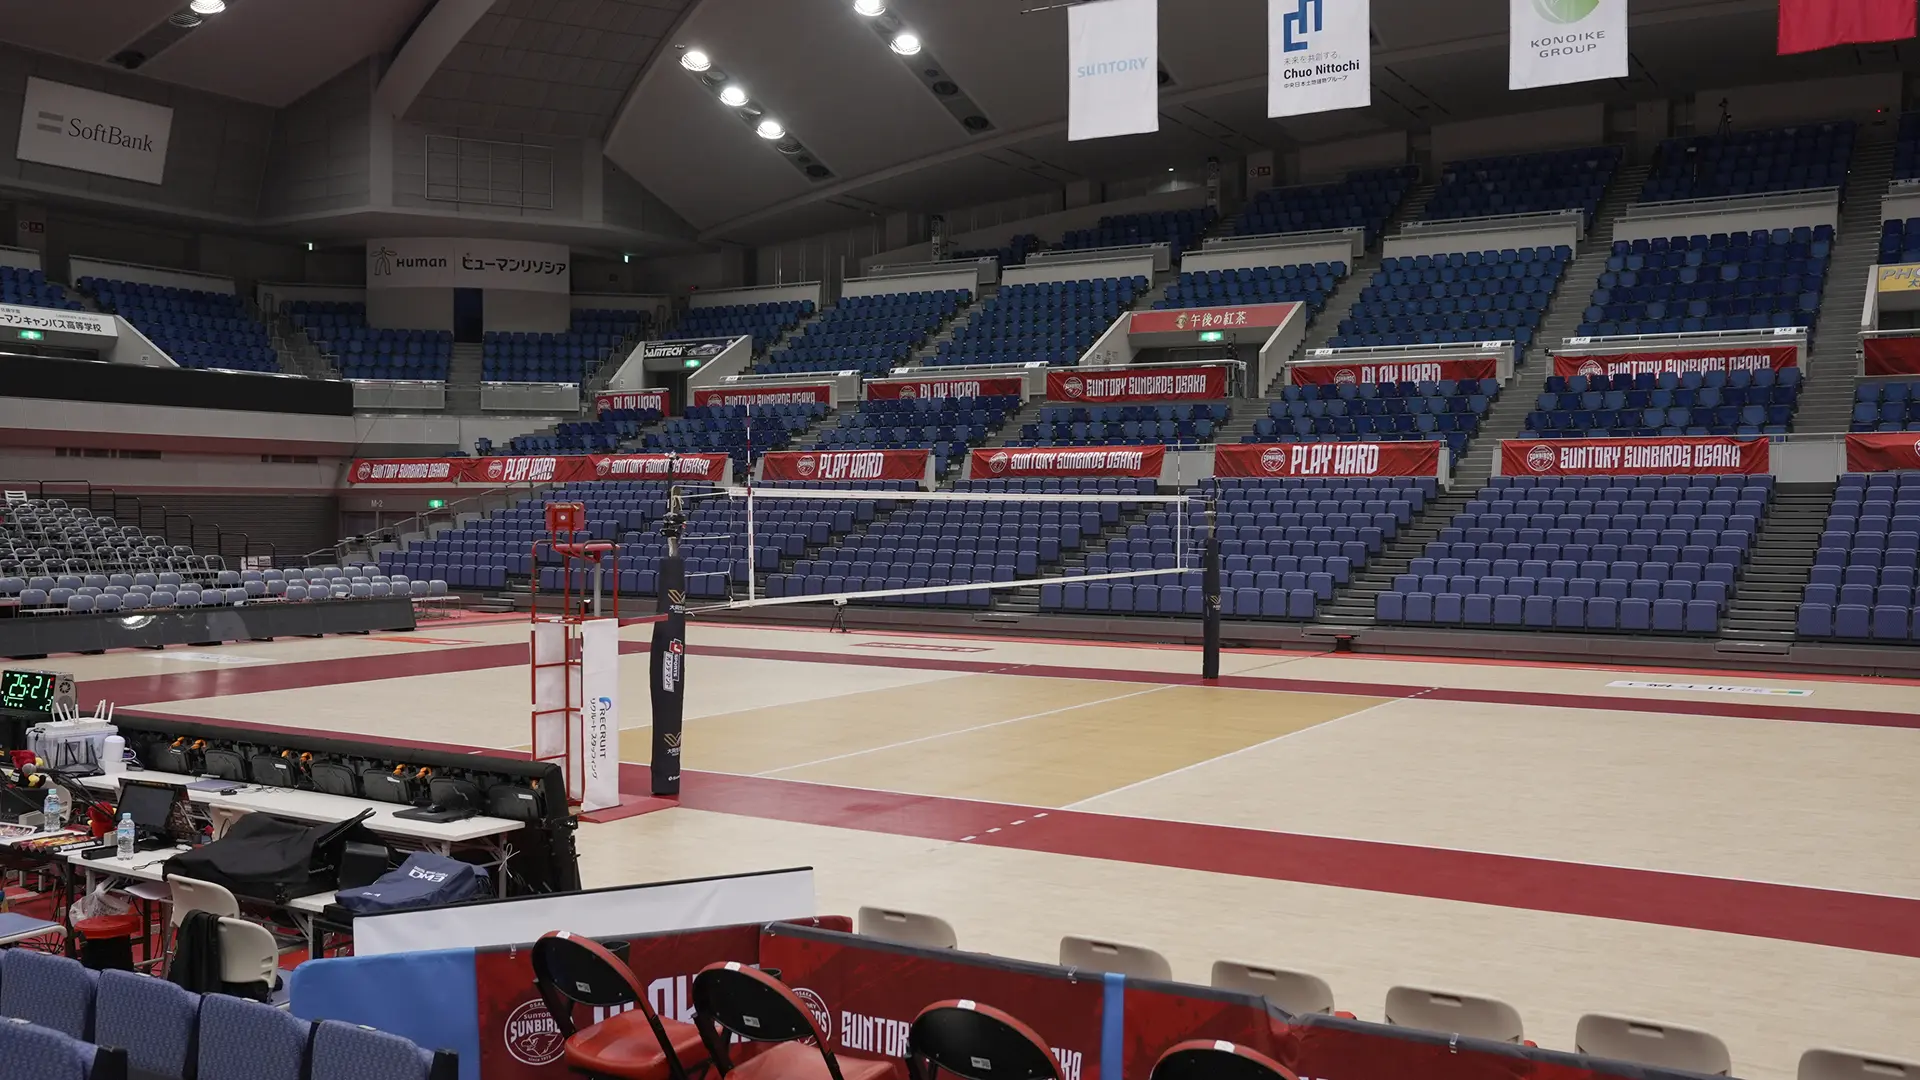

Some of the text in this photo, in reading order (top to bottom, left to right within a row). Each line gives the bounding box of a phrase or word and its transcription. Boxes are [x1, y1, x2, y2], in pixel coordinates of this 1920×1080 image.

[1531, 31, 1605, 48] KONOIKE
[1540, 44, 1597, 58] GROUP
[1077, 57, 1149, 78] SUNTORY
[1284, 59, 1360, 80] Chuo Nittochi
[68, 117, 153, 152] SoftBank
[1190, 311, 1247, 327] 午後の紅茶
[1086, 375, 1207, 397] SUNTORY SUNBIRDS OSAKA
[611, 459, 646, 474] SUNTORY
[682, 458, 710, 475] OSAKA
[818, 453, 884, 478] PLAY HARD
[1011, 452, 1144, 470] SUNTORY SUNBIRDS OSAKA
[1290, 445, 1379, 474] PLAY HARD
[1560, 445, 1740, 468] SUNTORY SUNBIRDS OSAKA
[371, 464, 400, 478] SUNTORY
[503, 457, 556, 480] PLAY HARD
[371, 499, 383, 508] M-2
[599, 708, 607, 758] RECRUIT
[523, 1012, 552, 1020] SUNTOR
[842, 1010, 913, 1058] SUNTOR
